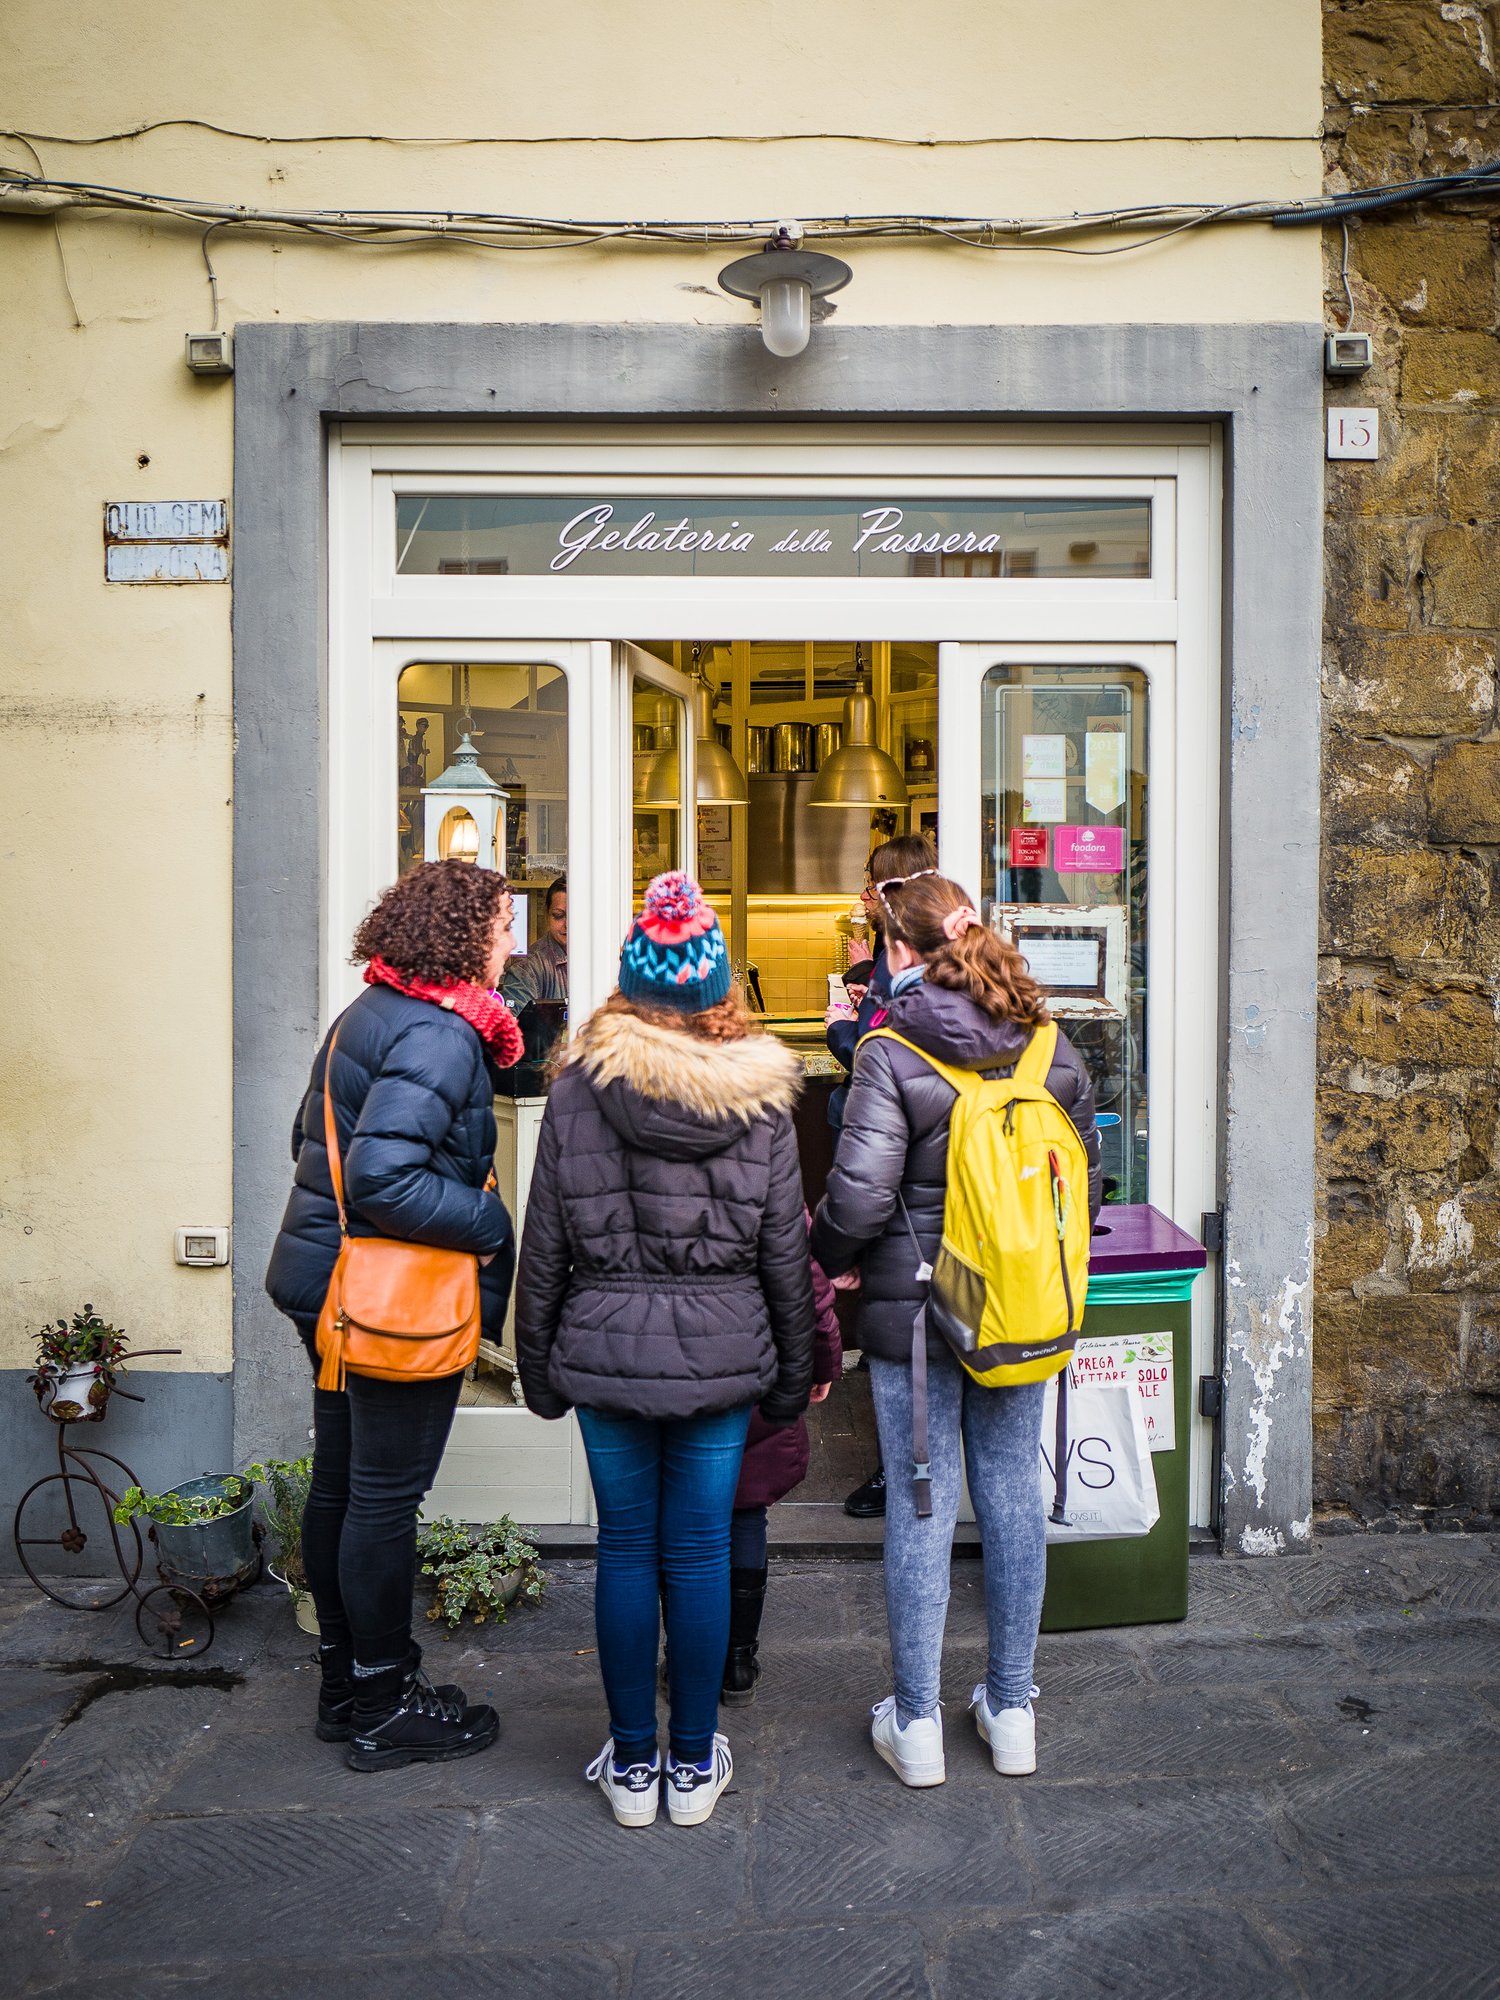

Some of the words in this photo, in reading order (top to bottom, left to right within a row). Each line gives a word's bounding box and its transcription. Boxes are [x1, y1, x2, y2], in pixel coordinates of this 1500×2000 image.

[1339, 419, 1370, 447] 15
[171, 503, 225, 536] SEMI
[549, 503, 755, 571] Gelateria
[768, 528, 833, 553] della
[852, 506, 1001, 553] Passera
[1070, 842, 1106, 852] foodora
[1022, 1345, 1058, 1358] Quechua
[1077, 1356, 1115, 1370] PREGA
[1138, 1367, 1168, 1382] SOLO
[1069, 1512, 1098, 1521] OVS.IT
